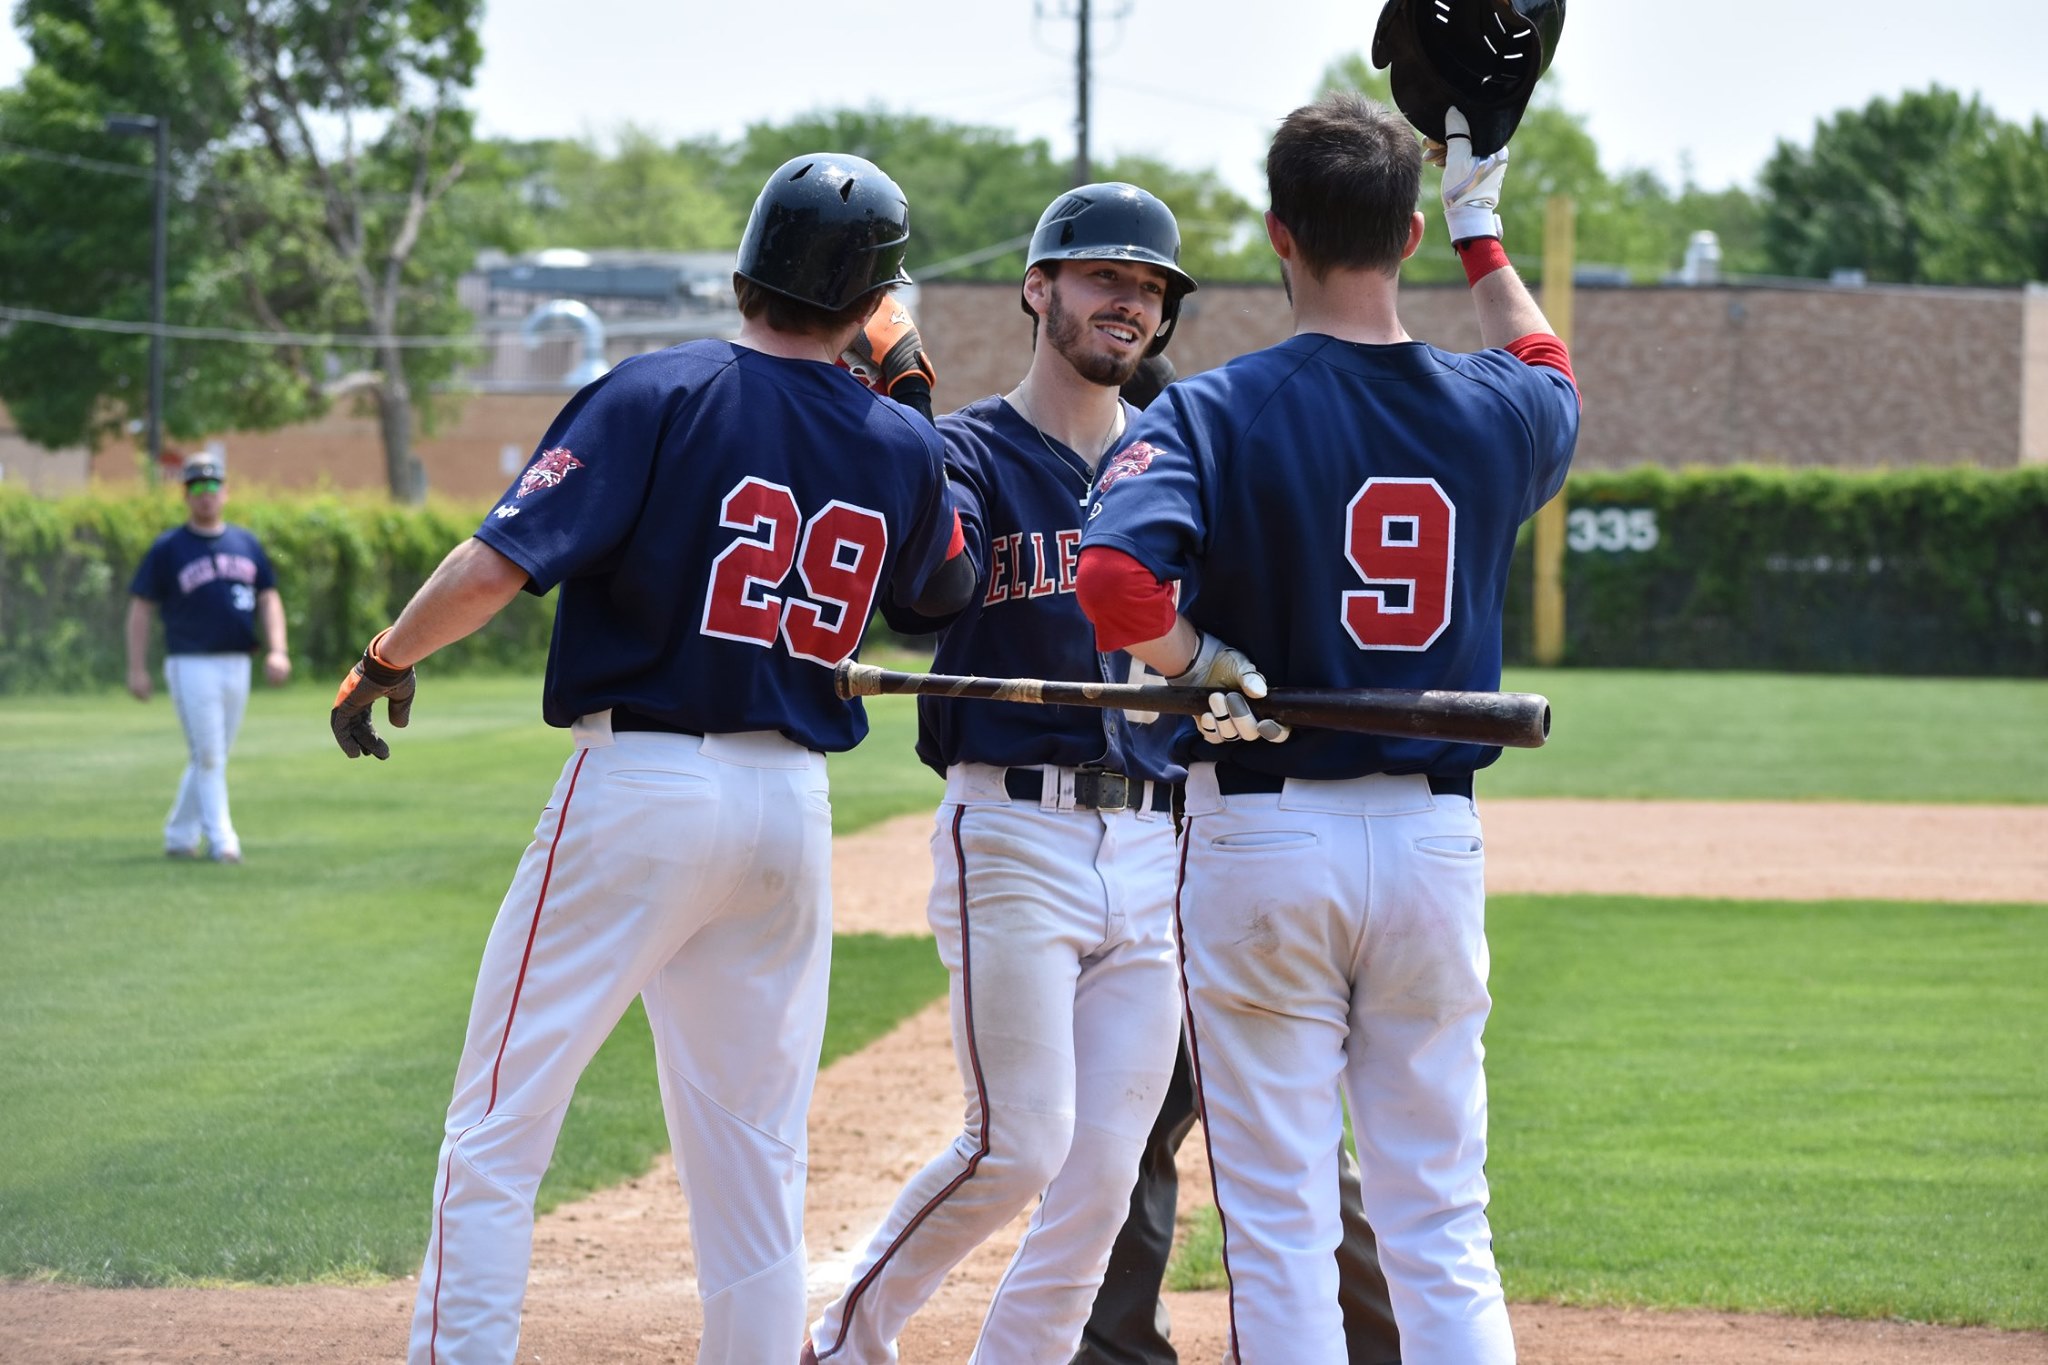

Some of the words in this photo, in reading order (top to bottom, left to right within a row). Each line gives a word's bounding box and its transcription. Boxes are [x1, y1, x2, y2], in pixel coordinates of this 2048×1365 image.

[700, 475, 889, 670] 29
[1340, 476, 1456, 652] 9
[1567, 508, 1660, 552] 335
